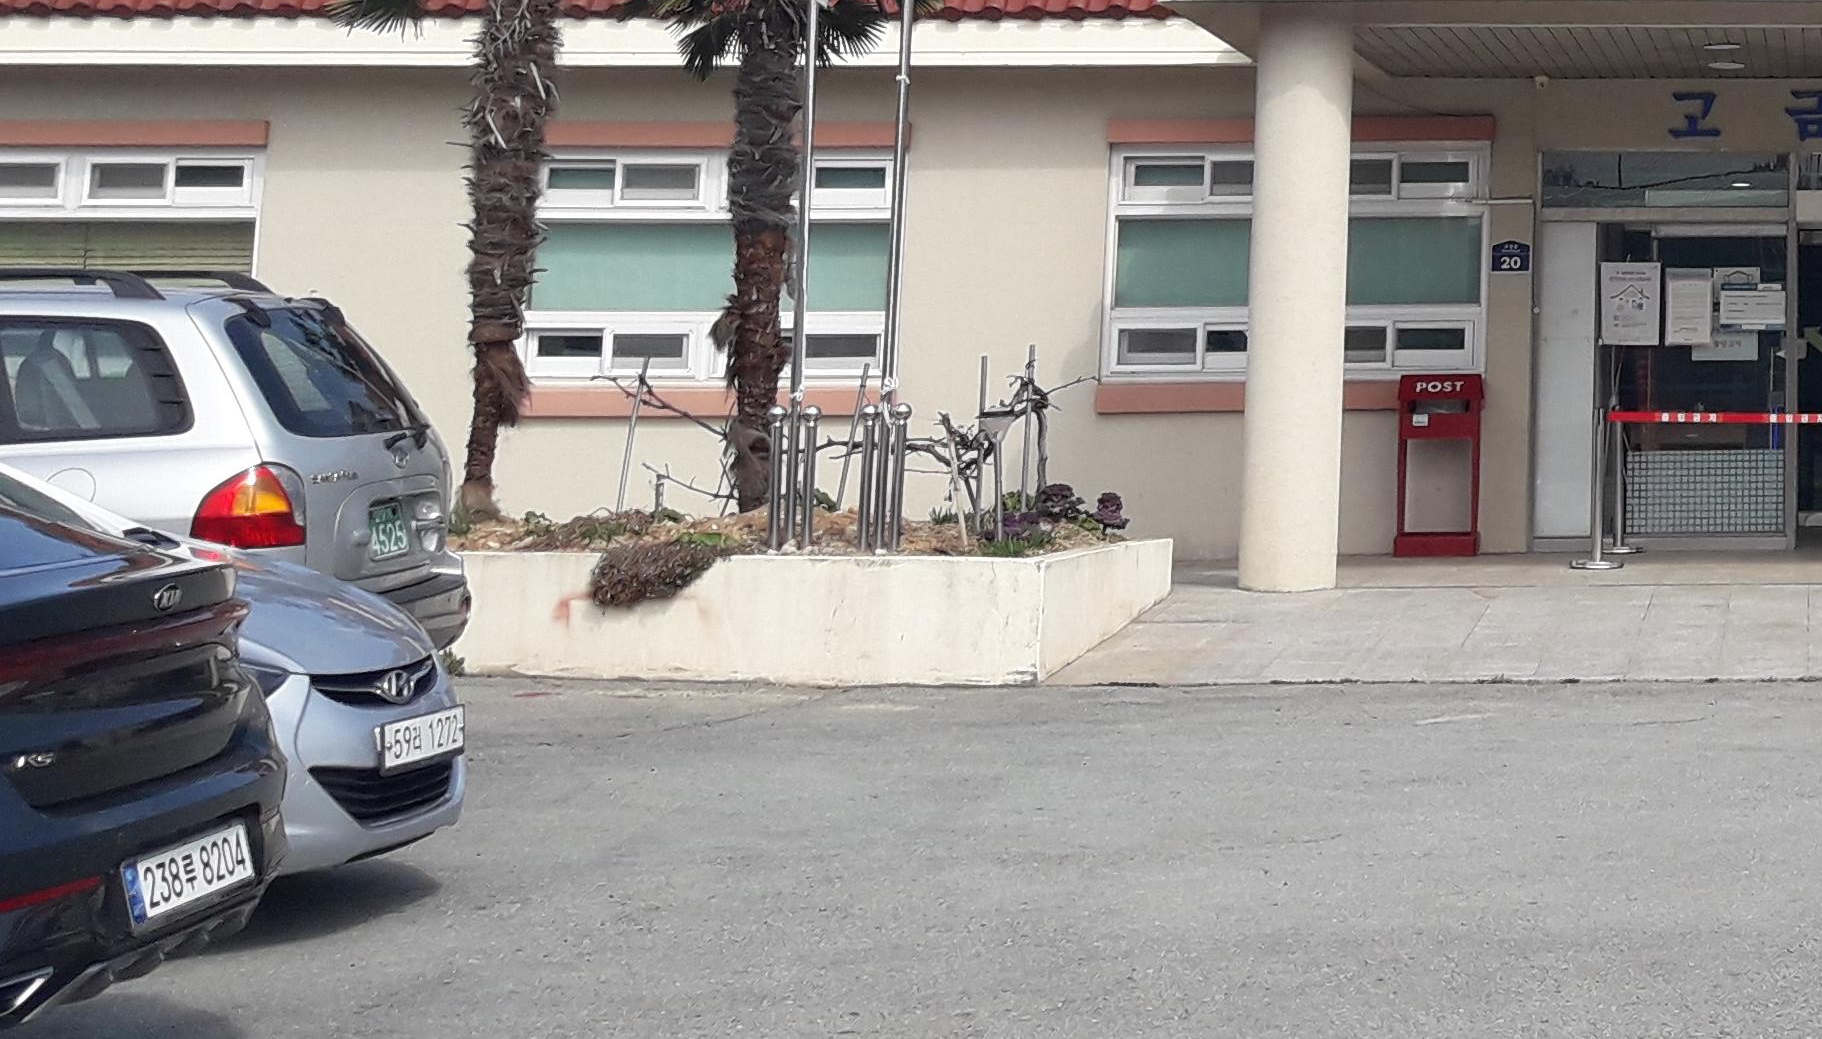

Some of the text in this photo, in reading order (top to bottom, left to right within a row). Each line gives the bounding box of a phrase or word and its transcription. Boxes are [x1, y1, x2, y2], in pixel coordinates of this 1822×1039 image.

[1500, 256, 1521, 269] 20
[1415, 380, 1465, 393] POST
[371, 520, 407, 556] 4525
[429, 714, 458, 750] 1272
[143, 831, 247, 909] 238루 8204
